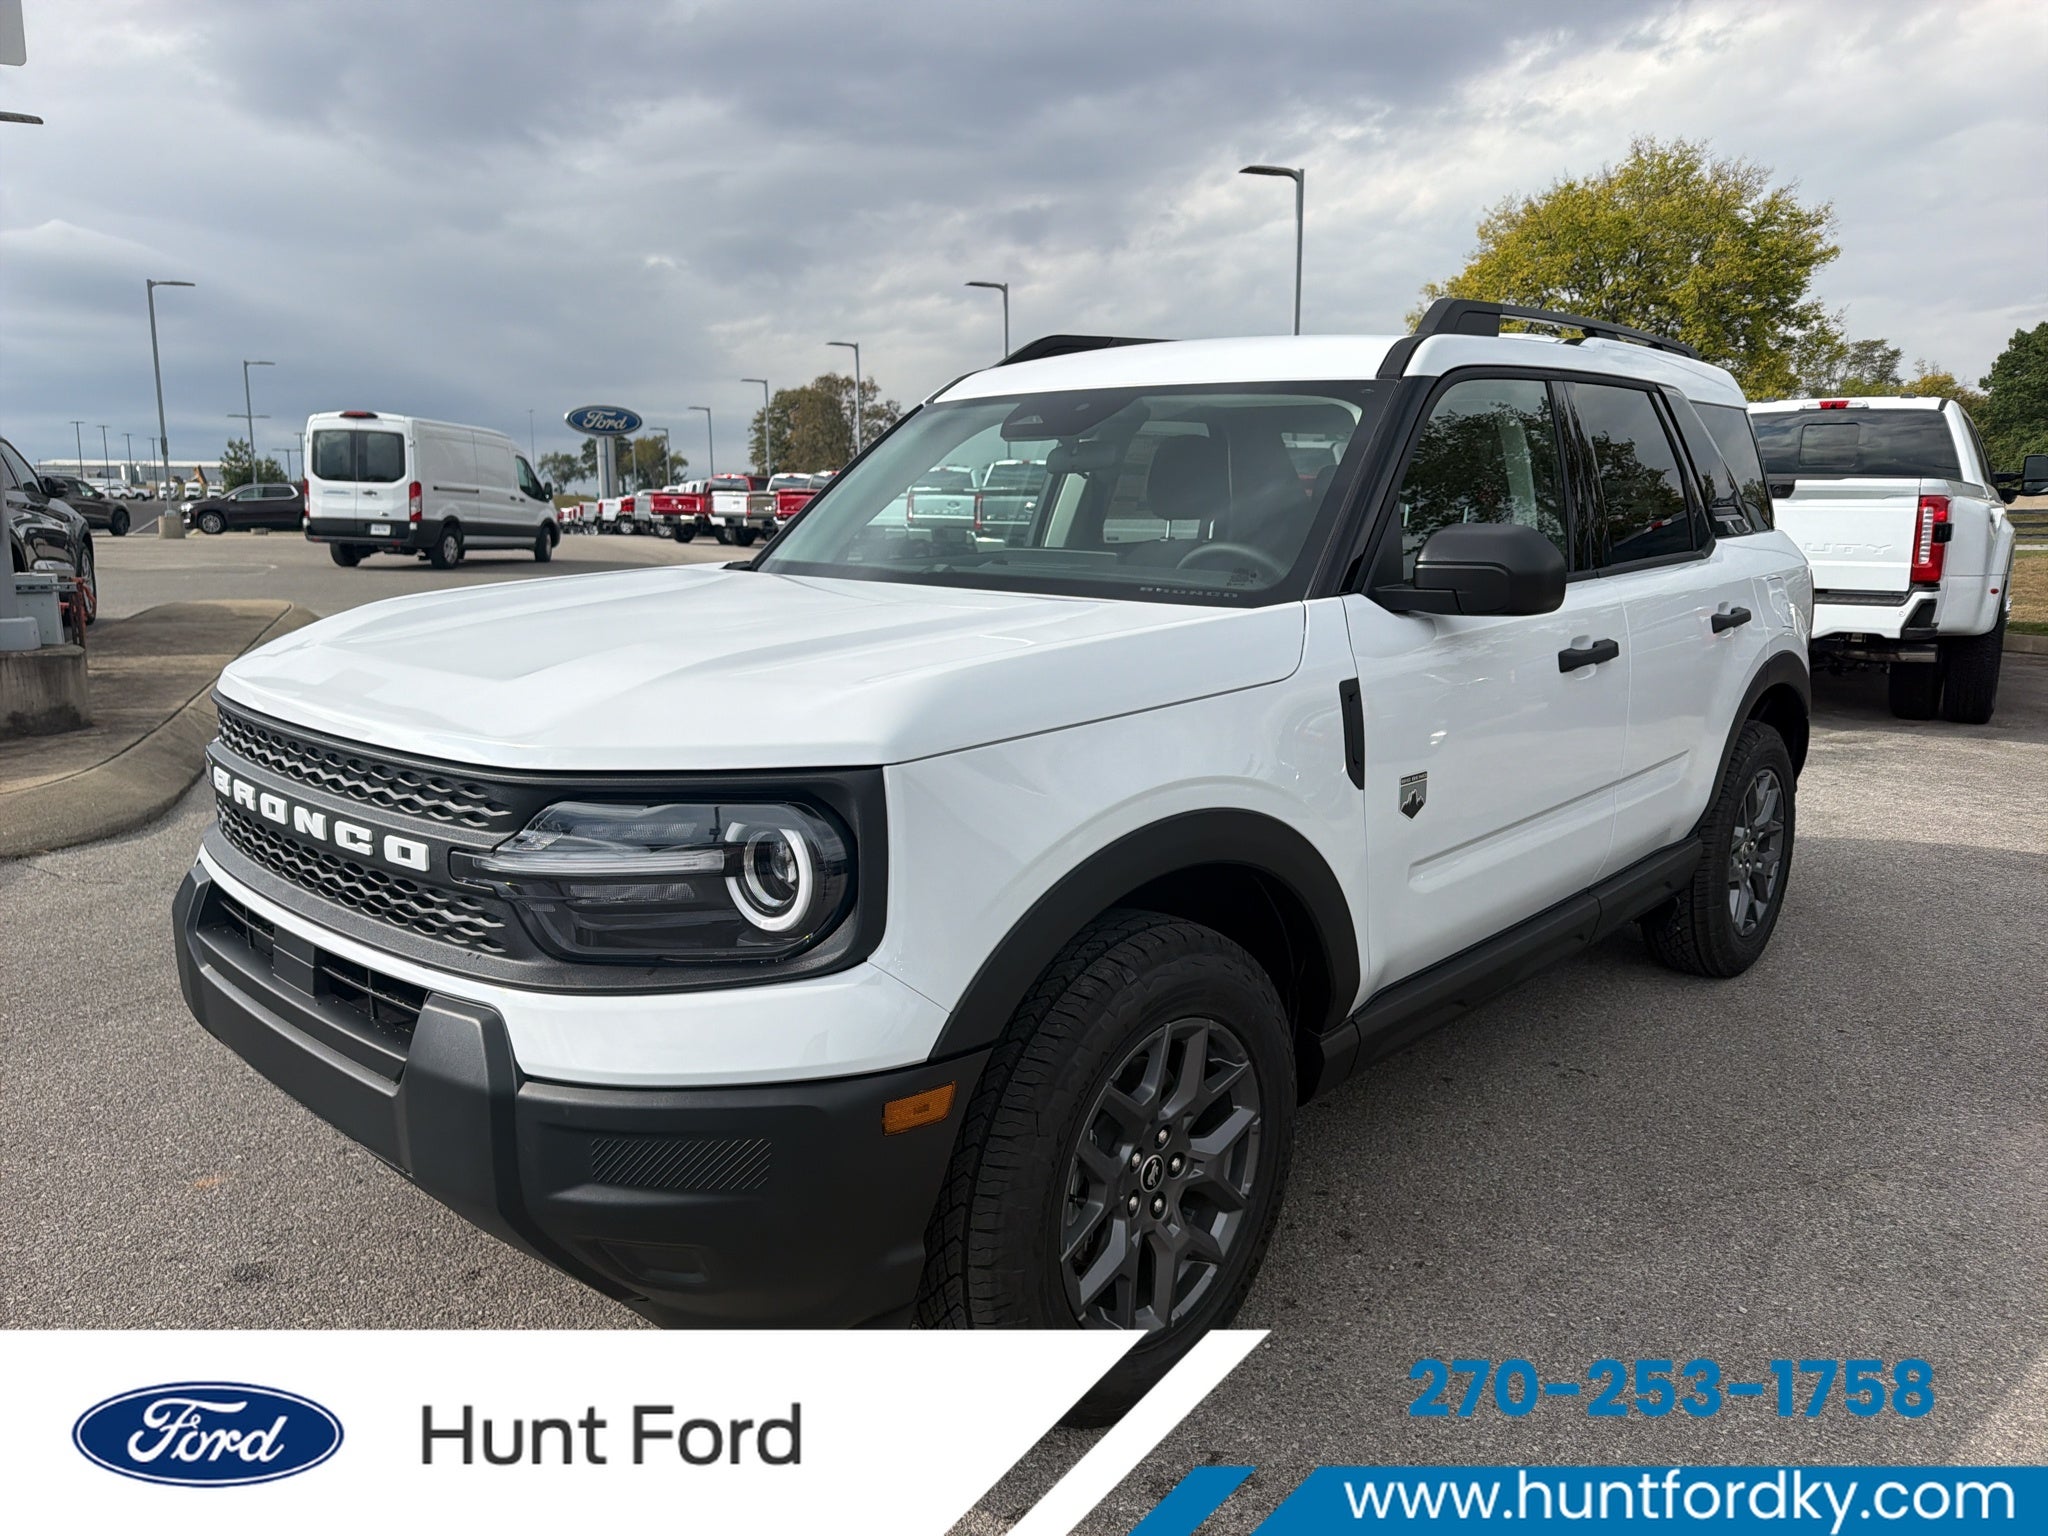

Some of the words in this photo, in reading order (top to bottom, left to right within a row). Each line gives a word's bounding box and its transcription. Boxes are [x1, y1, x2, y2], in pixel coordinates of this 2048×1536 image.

[582, 411, 627, 429] Ford
[1804, 543, 1893, 555] UTY
[213, 766, 430, 872] BRONCO
